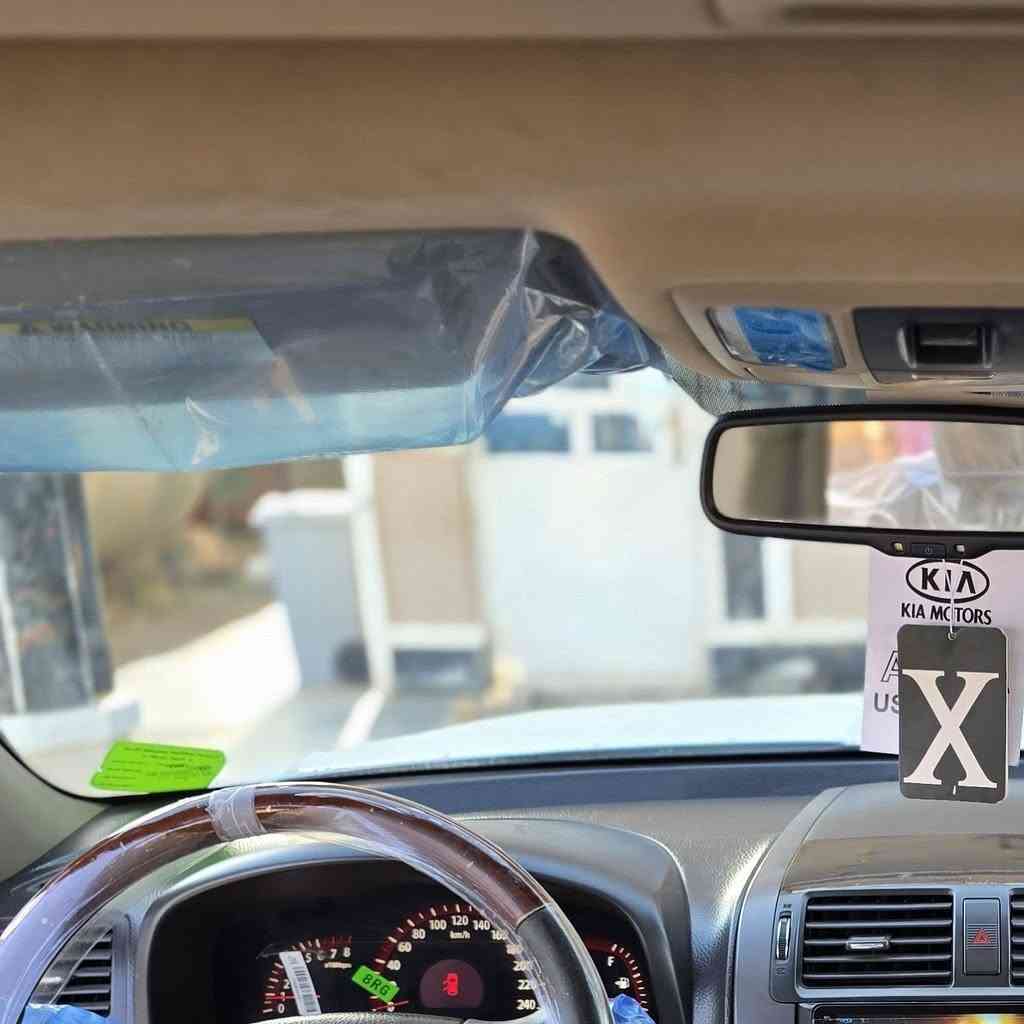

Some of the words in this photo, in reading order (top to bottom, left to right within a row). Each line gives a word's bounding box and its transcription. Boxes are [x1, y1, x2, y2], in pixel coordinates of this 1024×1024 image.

[921, 567, 976, 594] KIA
[901, 602, 926, 619] KIA
[930, 605, 992, 625] MOTORS
[902, 669, 999, 789] X
[429, 919, 447, 930] 100
[451, 915, 469, 926] 120
[473, 920, 490, 931] 140
[412, 929, 426, 939] 80
[343, 947, 351, 957] 8
[398, 942, 412, 952] 60
[305, 952, 312, 963] 5
[330, 948, 337, 959] 7
[386, 959, 401, 970] 40
[608, 956, 615, 967] F
[278, 1003, 285, 1014] 0
[516, 1000, 536, 1010] 240
